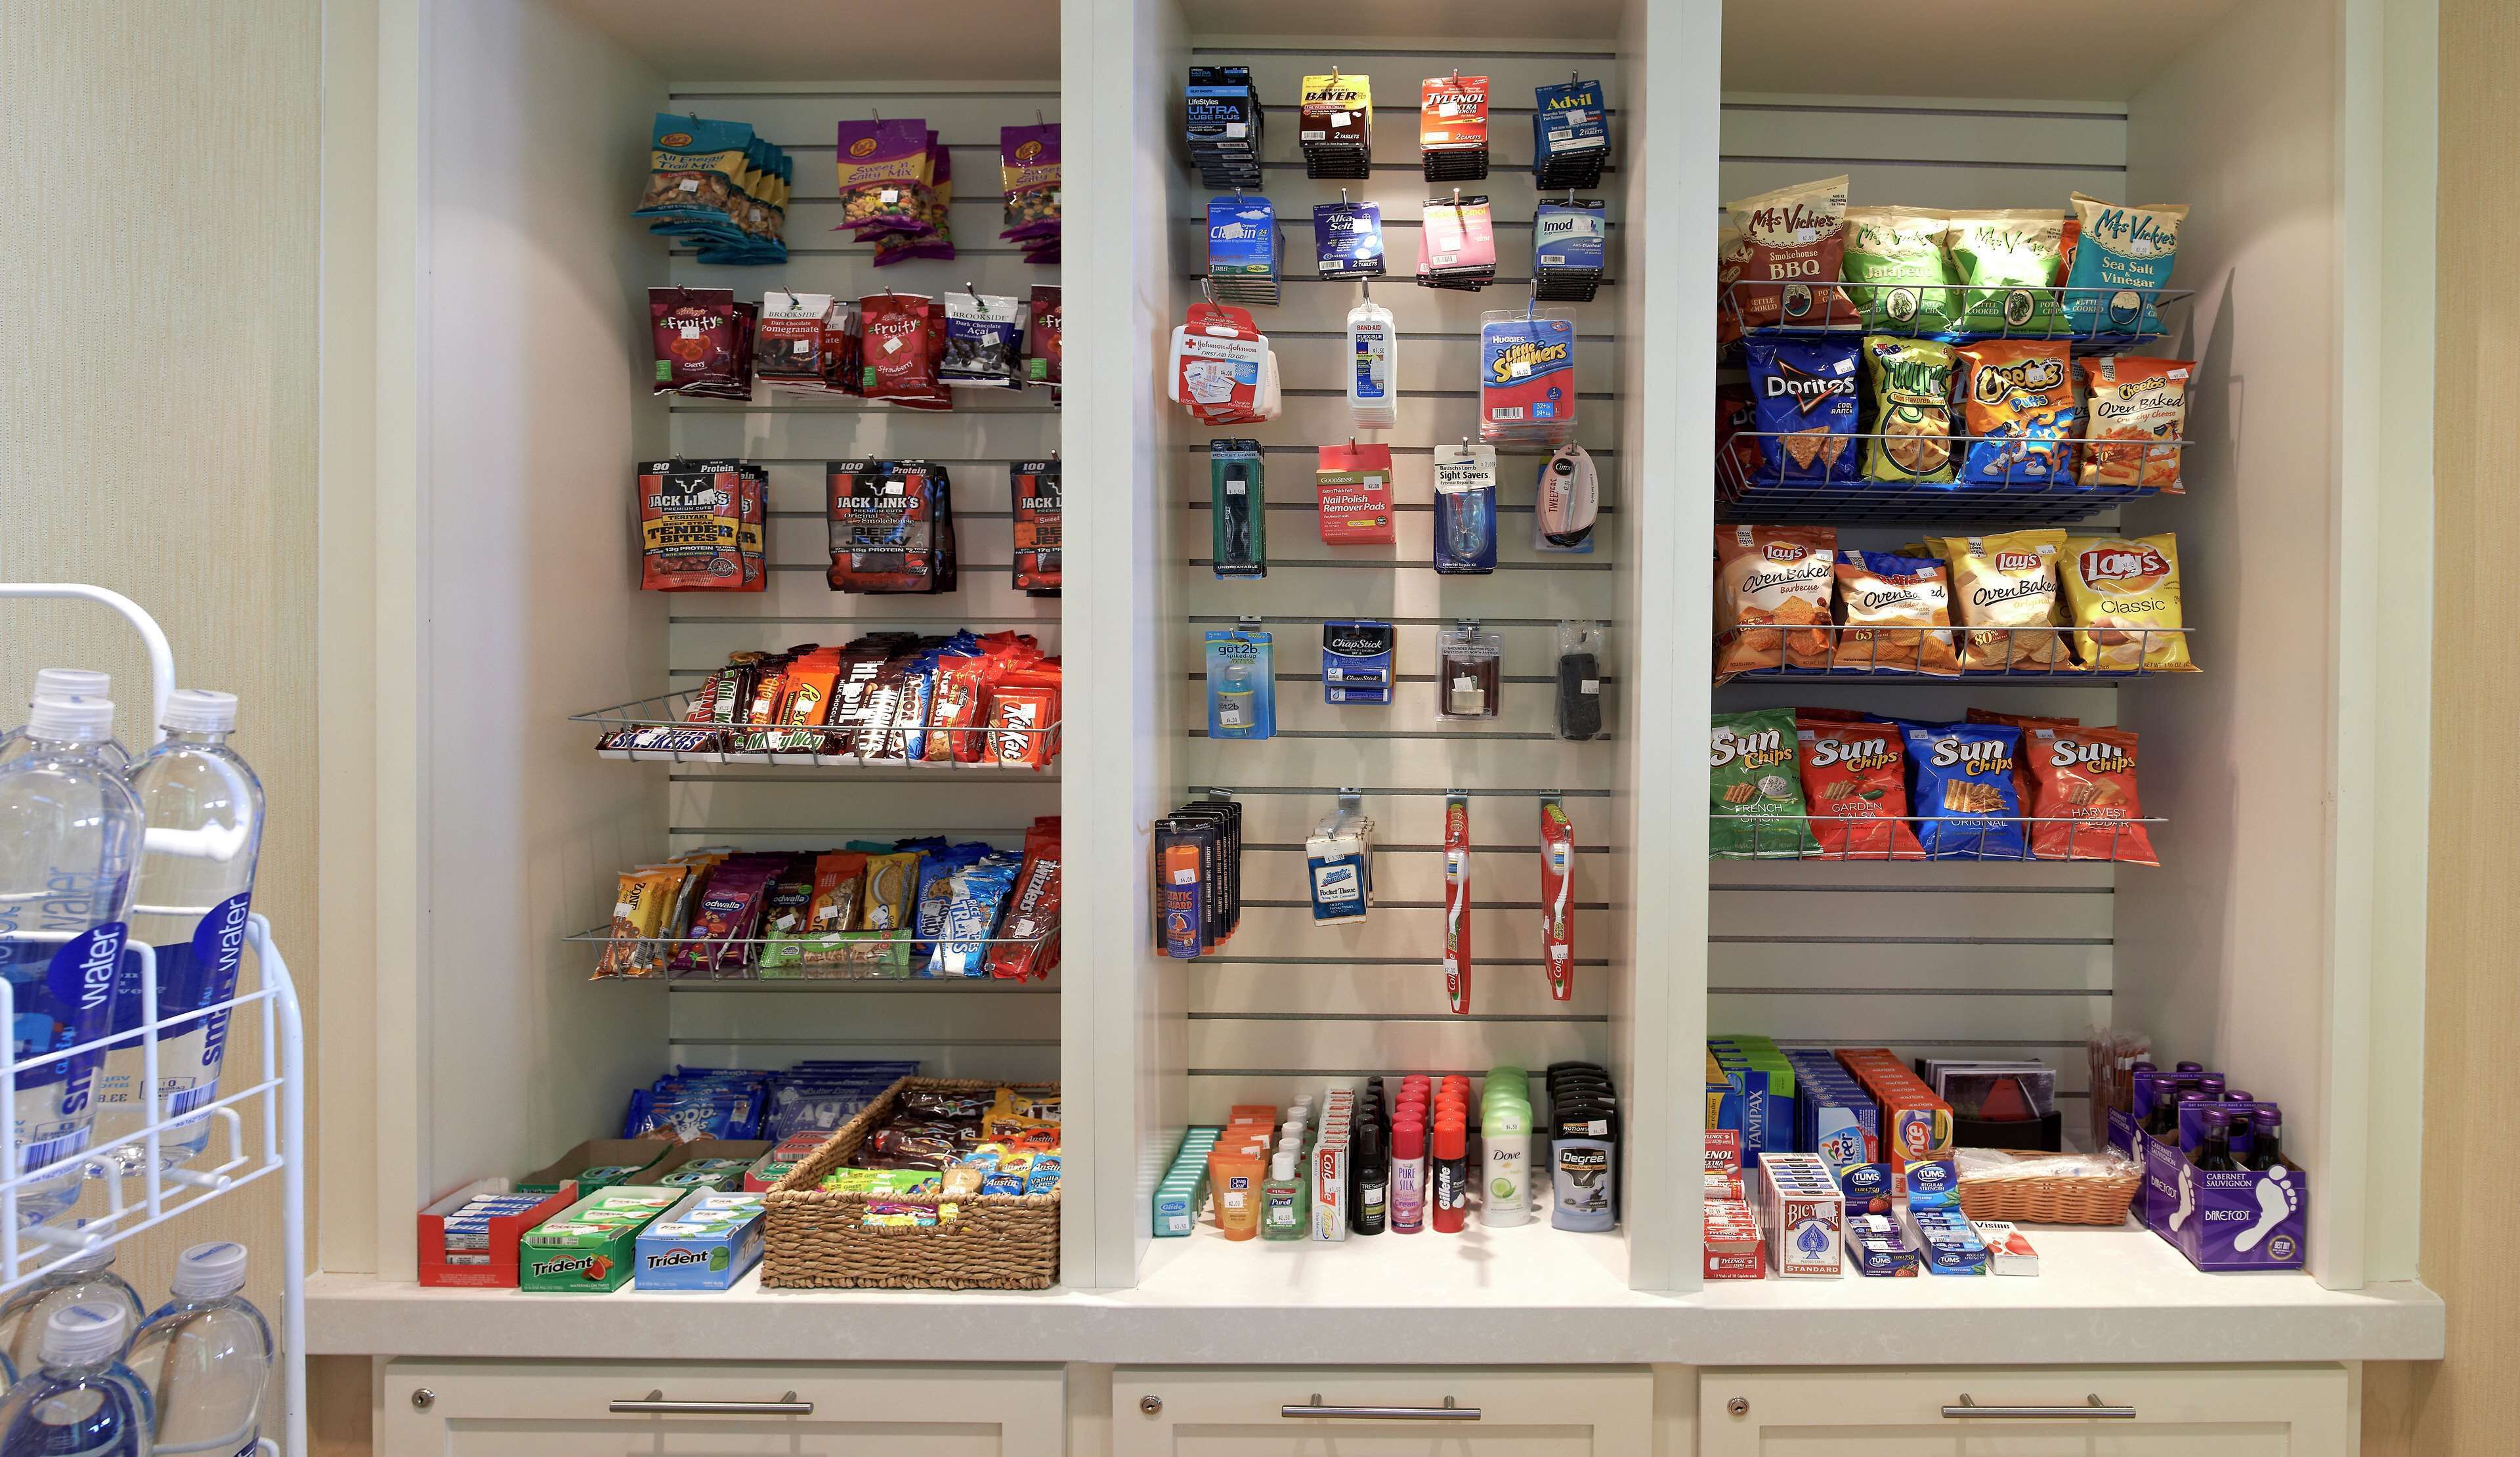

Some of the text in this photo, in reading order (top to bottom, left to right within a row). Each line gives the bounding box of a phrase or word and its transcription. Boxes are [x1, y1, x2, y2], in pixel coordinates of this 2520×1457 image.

[1305, 92, 1357, 100] BAYER
[1427, 93, 1484, 105] TYLENOL
[1547, 93, 1592, 110] Advil
[679, 154, 724, 163] Energy
[856, 166, 894, 175] Sweet
[888, 167, 912, 177] Mix
[1782, 204, 1835, 234] Vickie's
[2129, 215, 2175, 251] Vickie's
[1770, 250, 1818, 261] Smokehouse
[1768, 259, 1820, 280] BBQ
[2102, 257, 2154, 275] Sea Salt
[2101, 272, 2154, 288] Vinegar
[953, 312, 1007, 320] BROOKSIDE
[878, 360, 913, 374] Strawberry
[1767, 376, 1855, 397] Doritos
[2120, 378, 2166, 399] Cheetos
[1905, 395, 1930, 404] Flavored
[2011, 395, 2049, 411] Puffs
[2098, 393, 2185, 418] Oven Baked
[892, 466, 926, 475] Protein
[1440, 471, 1461, 481] Sight
[649, 495, 682, 508] JACK
[837, 496, 918, 508] JACK LINK'S
[1021, 498, 1054, 509] JACK
[1323, 495, 1368, 504] Nail Polish
[1323, 502, 1385, 512] Remover Pads
[648, 525, 733, 539] TENDER
[660, 534, 717, 544] BITES
[1768, 546, 1805, 561] Lay's
[1998, 553, 2037, 571] Lay's
[1742, 574, 1785, 592] Oven
[1780, 584, 1820, 594] Barbecue
[1865, 591, 1904, 607] Oven
[1973, 587, 2018, 605] Oven
[2101, 597, 2166, 614] Classic
[1332, 639, 1382, 649] ChapStick
[1711, 729, 1781, 766] Sun
[1811, 738, 1887, 766] Sun
[1931, 739, 2005, 766] Sun
[2050, 740, 2122, 766] Sun
[1744, 748, 1793, 768] Chips
[1846, 752, 1898, 772] Chips
[2086, 756, 2135, 773] Chips
[1965, 757, 2013, 776] Chips
[1735, 804, 1782, 813] FRENCH
[1832, 802, 1883, 812] GARDEN
[2072, 808, 2126, 817] HARVEST
[1019, 859, 1059, 913] Twizzlers
[773, 894, 805, 902] odwalla
[1166, 892, 1192, 902] STATIC
[705, 900, 740, 909] odwalla
[1167, 901, 1192, 909] GUARD
[1749, 1090, 1763, 1151] TAMPAX
[1493, 1150, 1521, 1160] Dove
[2151, 1141, 2172, 1157] CABERNET
[1563, 1152, 1604, 1165] Degree
[2151, 1148, 2176, 1167] SAUVIGNON
[1398, 1167, 1415, 1179] PURE
[1854, 1172, 1880, 1181] TUMS
[1921, 1170, 1945, 1179] TUMS
[1399, 1179, 1414, 1190] SILK
[1439, 1166, 1451, 1210] Gillette
[2151, 1176, 2177, 1200] BAREFOOT
[2205, 1211, 2250, 1221] BAREFOOT
[532, 1255, 593, 1277] Trident
[647, 1251, 708, 1270] Trident
